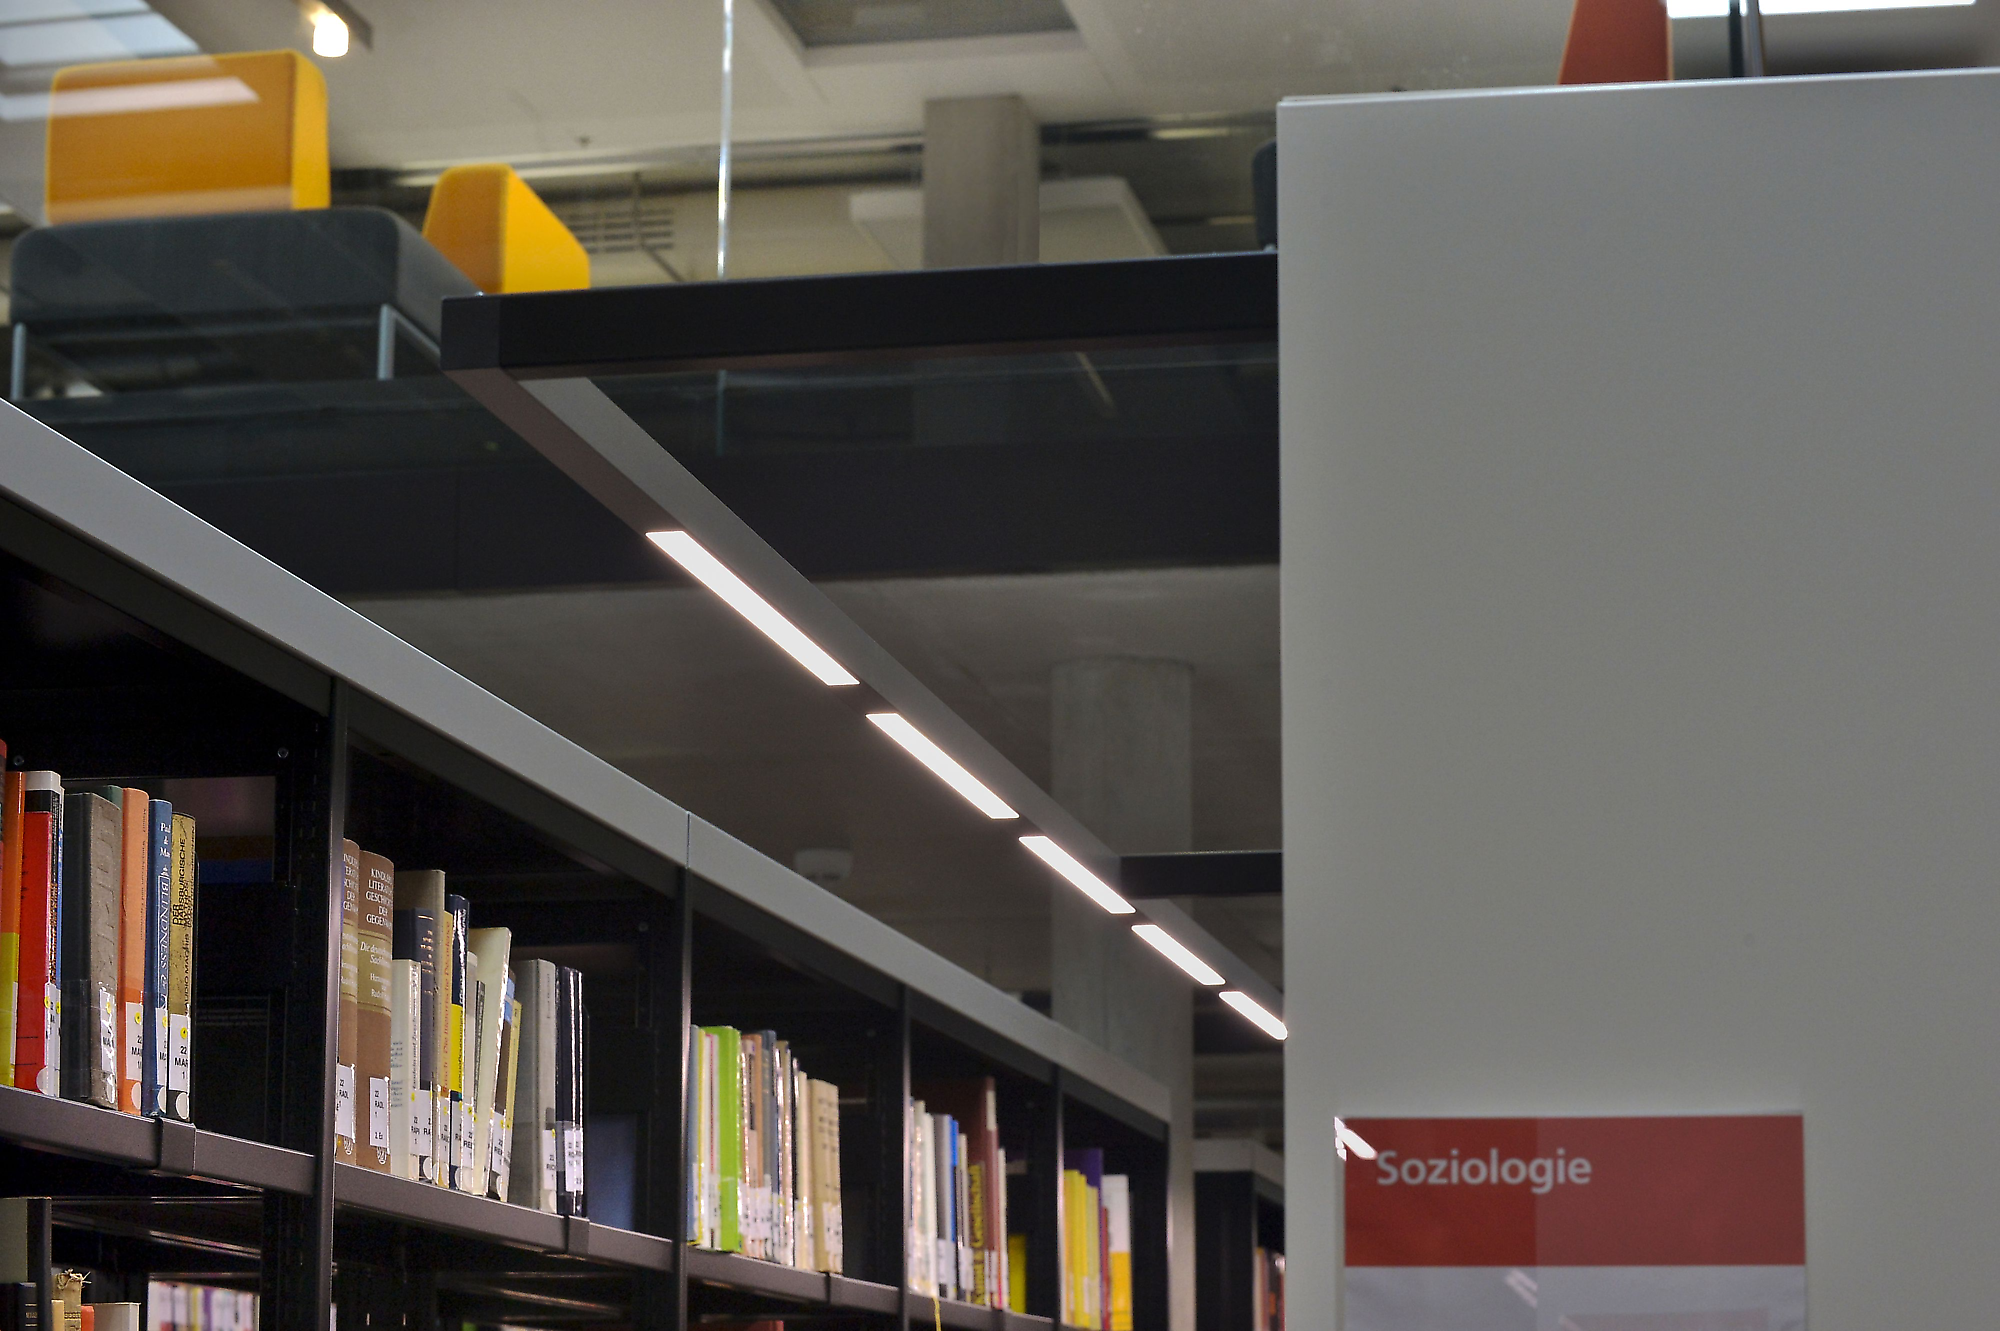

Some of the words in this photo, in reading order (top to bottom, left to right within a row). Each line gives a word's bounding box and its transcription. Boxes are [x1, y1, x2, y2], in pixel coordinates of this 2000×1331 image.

[160, 881, 169, 969] BLINDNESS
[180, 1046, 187, 1055] 22
[1376, 1148, 1593, 1194] Soziologie
